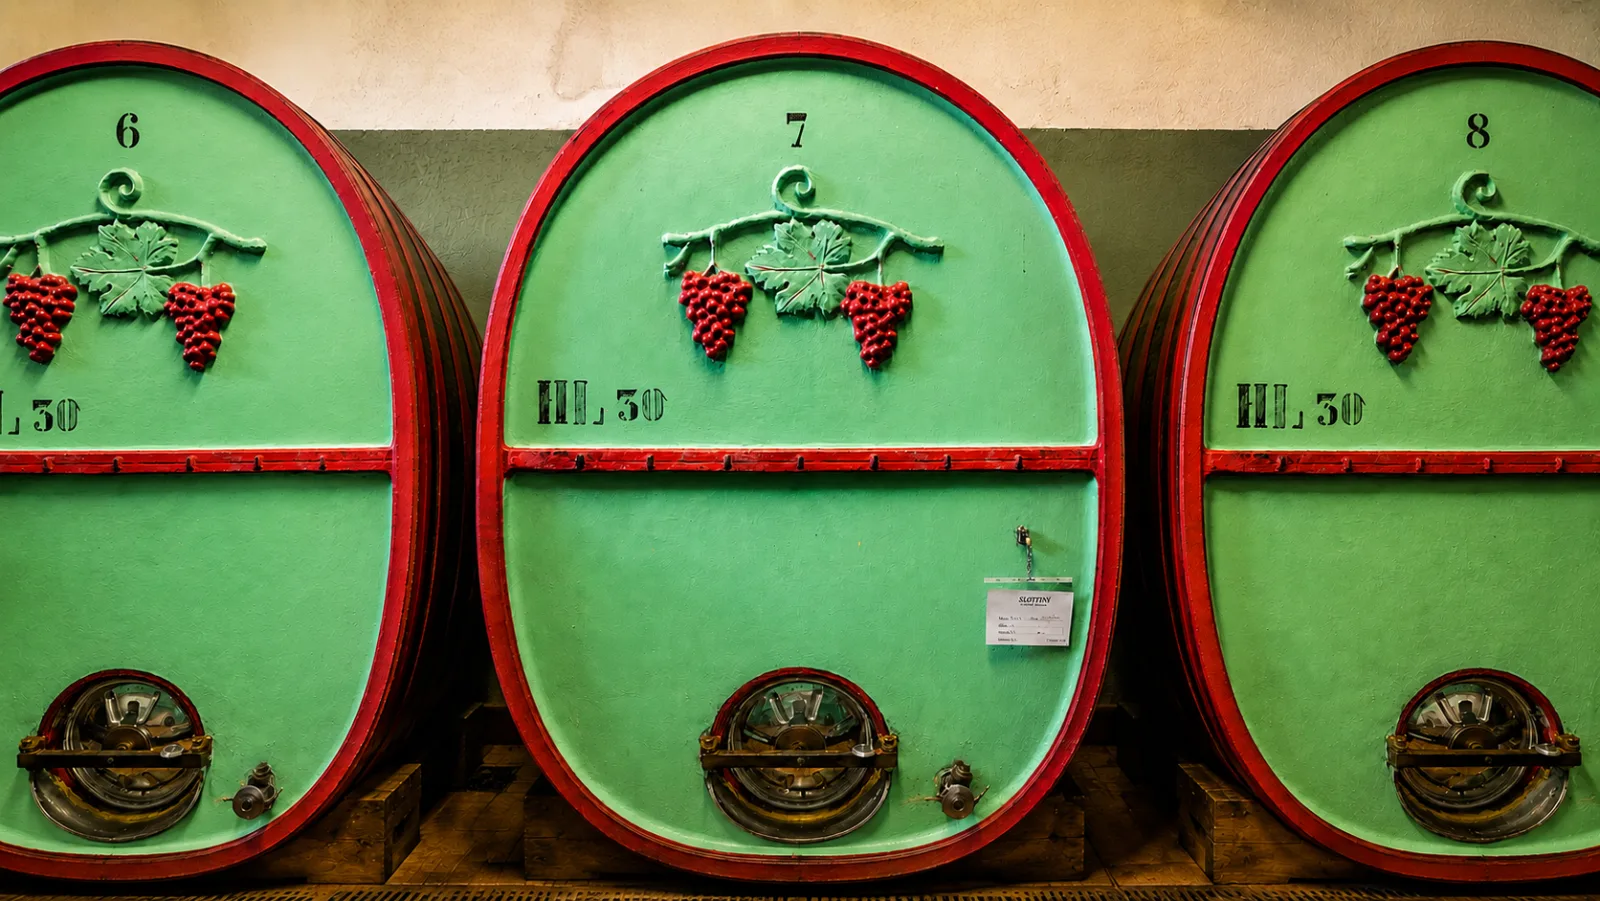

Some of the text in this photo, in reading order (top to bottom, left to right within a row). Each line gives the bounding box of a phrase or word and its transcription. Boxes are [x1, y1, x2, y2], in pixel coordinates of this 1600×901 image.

[116, 112, 140, 149] 6
[786, 112, 807, 149] 7
[1466, 113, 1491, 149] 8
[32, 398, 81, 432] 30
[536, 379, 668, 426] HL 30
[1236, 383, 1366, 430] HL 30
